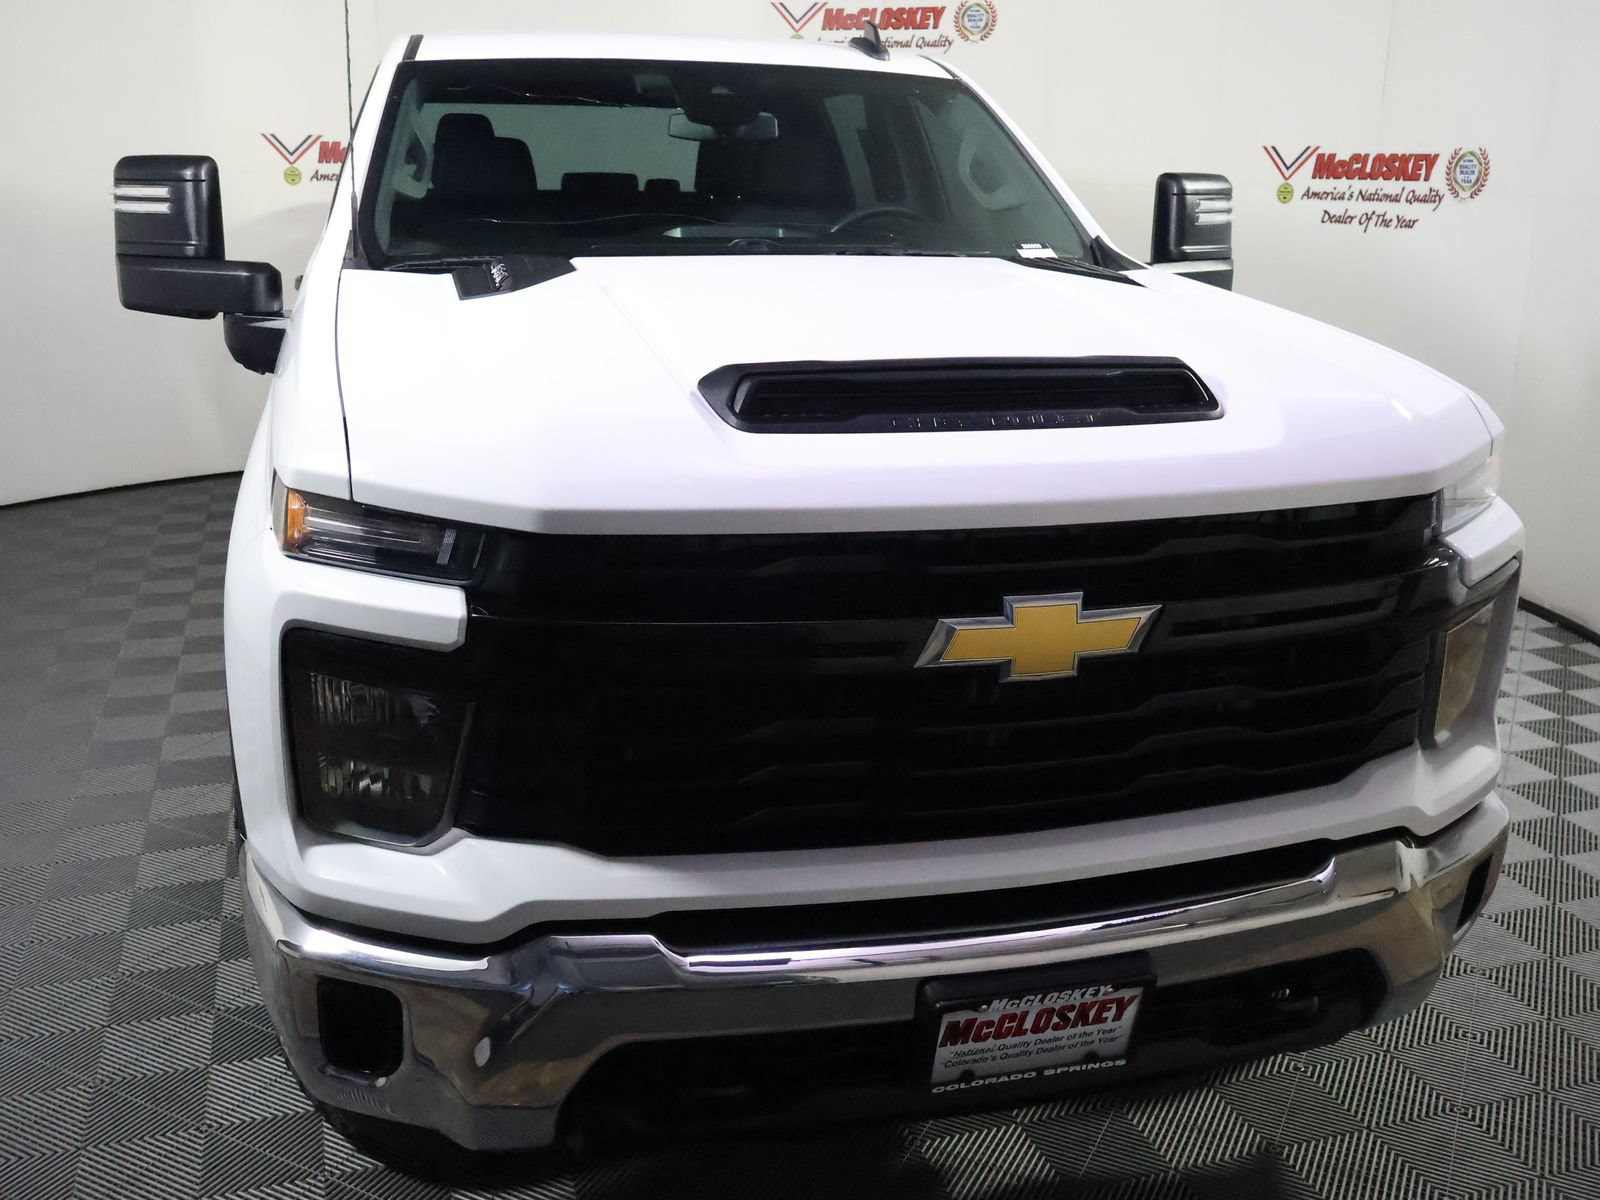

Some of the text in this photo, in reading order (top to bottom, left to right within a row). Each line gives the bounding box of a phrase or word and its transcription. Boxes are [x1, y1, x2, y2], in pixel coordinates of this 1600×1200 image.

[821, 6, 947, 31] McCLOSKEY
[916, 33, 954, 54] Quality
[1311, 152, 1441, 182] McCLOSKEY
[1301, 185, 1354, 202] America's
[1355, 186, 1405, 204] National
[1405, 187, 1445, 212] Quality
[1321, 208, 1419, 233] Dealer Of The Year
[988, 984, 1113, 1012] McCLOSKEY
[938, 995, 1139, 1048] McCLOSKEY
[998, 1039, 1032, 1052] Quality
[1034, 1035, 1065, 1046] Dealer
[1066, 1032, 1077, 1040] of
[1079, 1030, 1094, 1038] the
[1000, 1049, 1034, 1061] Quality
[1036, 1043, 1067, 1055] Dealer
[1068, 1041, 1079, 1049] of
[1080, 1039, 1095, 1047] the
[931, 1059, 1127, 1093] COLORADO SPRINGS
